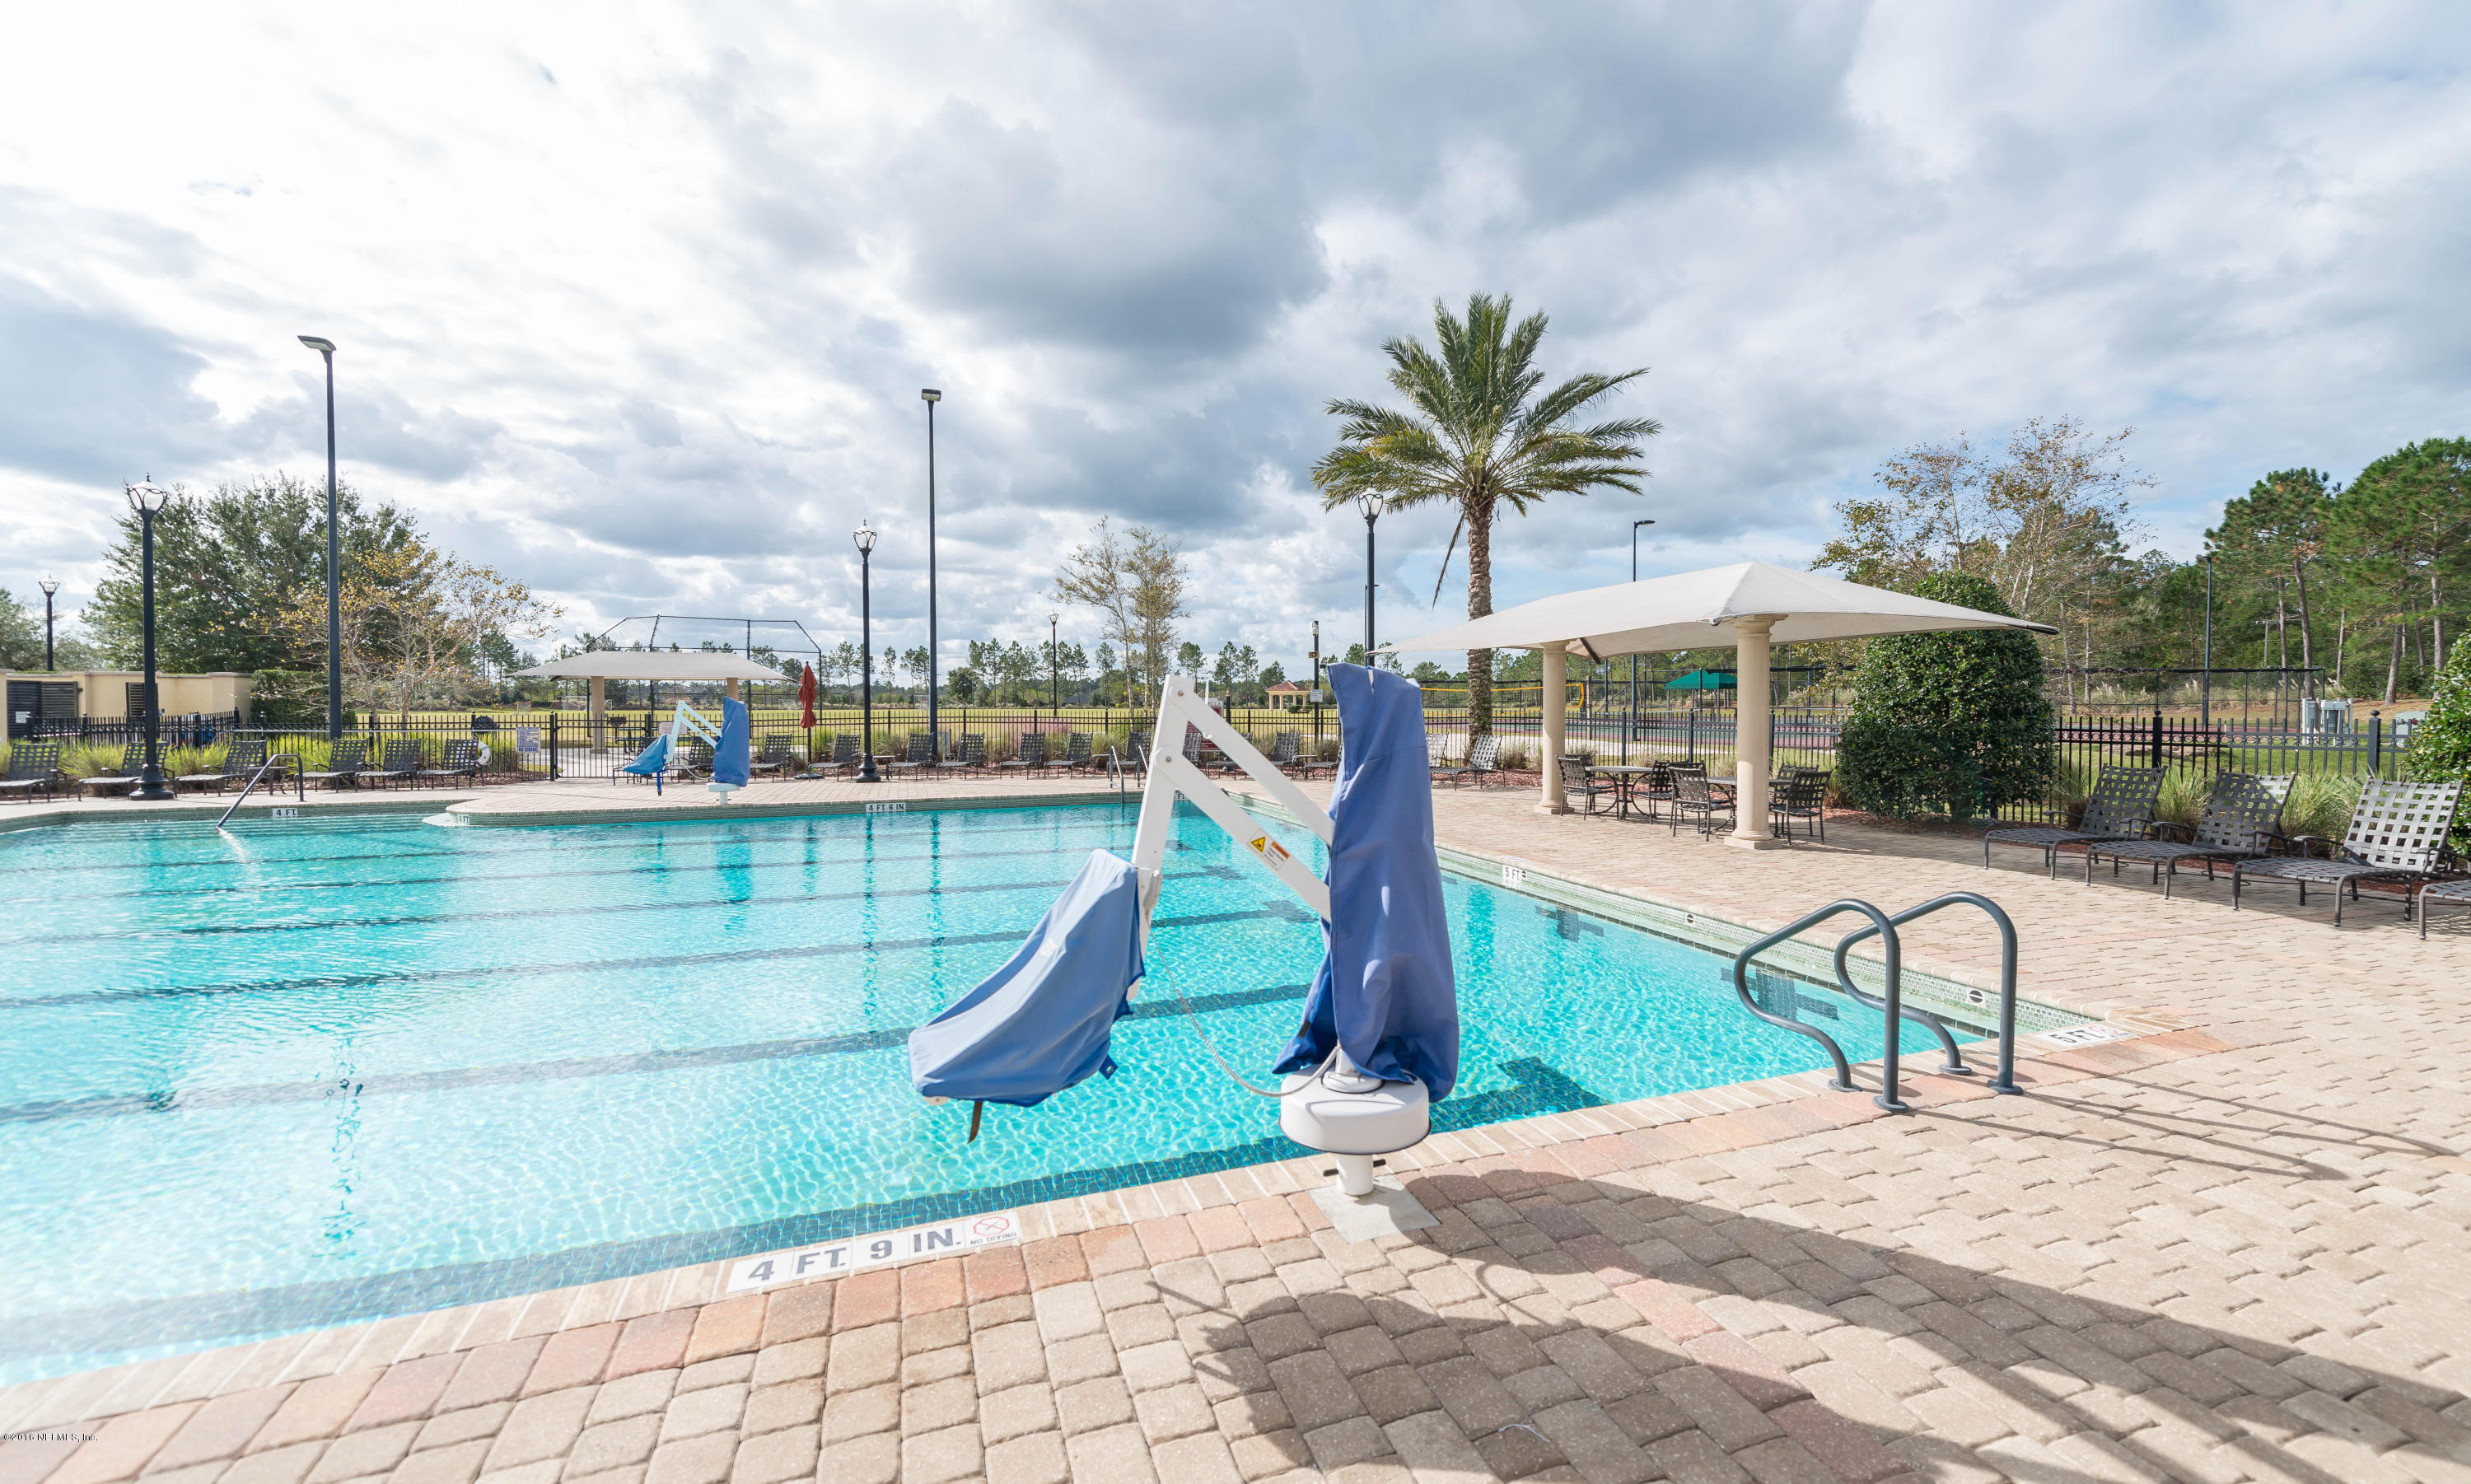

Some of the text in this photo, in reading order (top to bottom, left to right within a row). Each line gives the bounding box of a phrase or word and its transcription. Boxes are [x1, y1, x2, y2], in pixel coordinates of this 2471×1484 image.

[1505, 866, 1520, 881] 5 FT
[2048, 1034, 2078, 1043] 5
[2065, 1029, 2106, 1041] FT
[987, 1231, 1017, 1242] DIVING
[748, 1228, 962, 1281] 4 FT. 9 IN.
